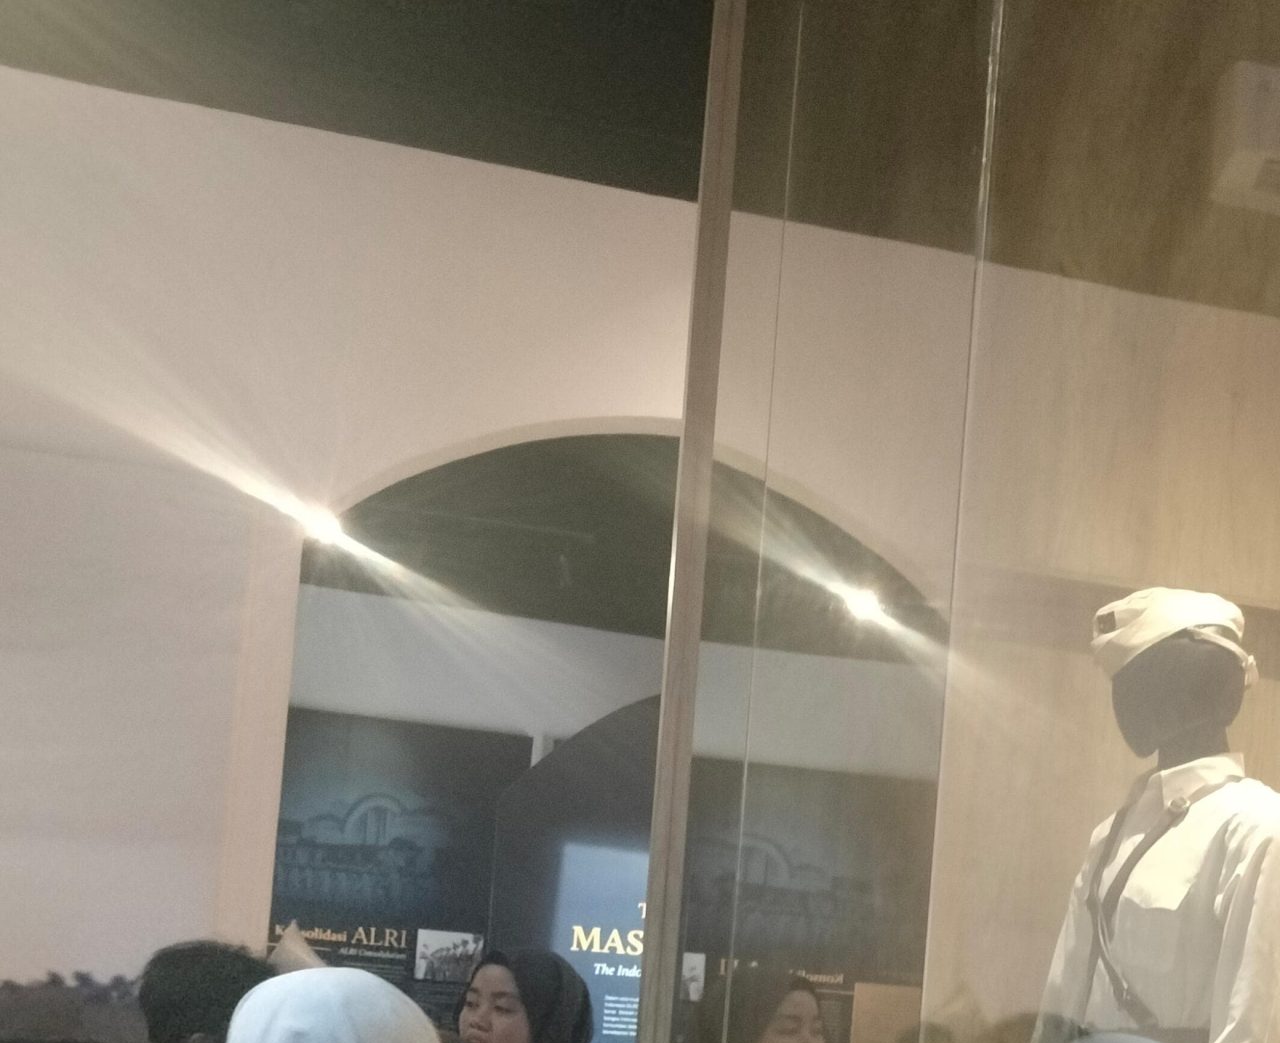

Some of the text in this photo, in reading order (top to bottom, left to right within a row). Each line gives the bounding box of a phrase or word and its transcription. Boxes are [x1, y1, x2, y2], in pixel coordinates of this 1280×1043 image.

[275, 924, 408, 948] Ksolidasi ALRI
[570, 925, 644, 956] MAS
[593, 963, 615, 976] The
